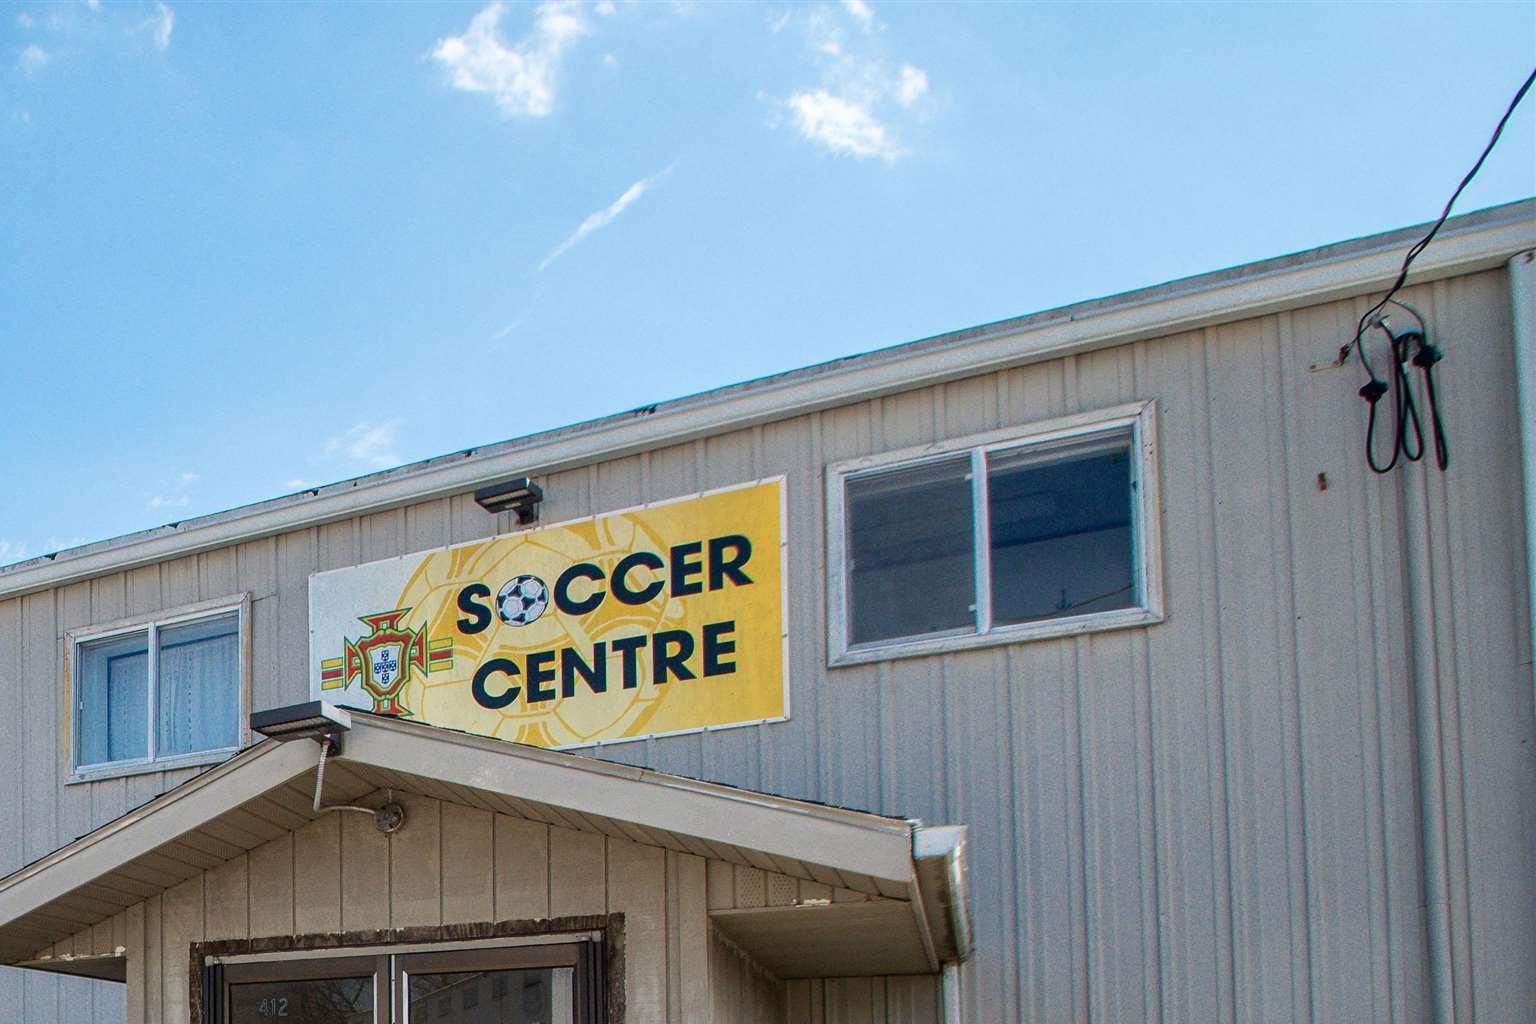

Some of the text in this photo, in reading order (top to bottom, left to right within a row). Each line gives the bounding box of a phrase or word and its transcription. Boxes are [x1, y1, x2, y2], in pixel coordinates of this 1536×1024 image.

[456, 533, 754, 635] SOCCER
[471, 619, 737, 711] CENTRE
[256, 998, 289, 1016] 412
